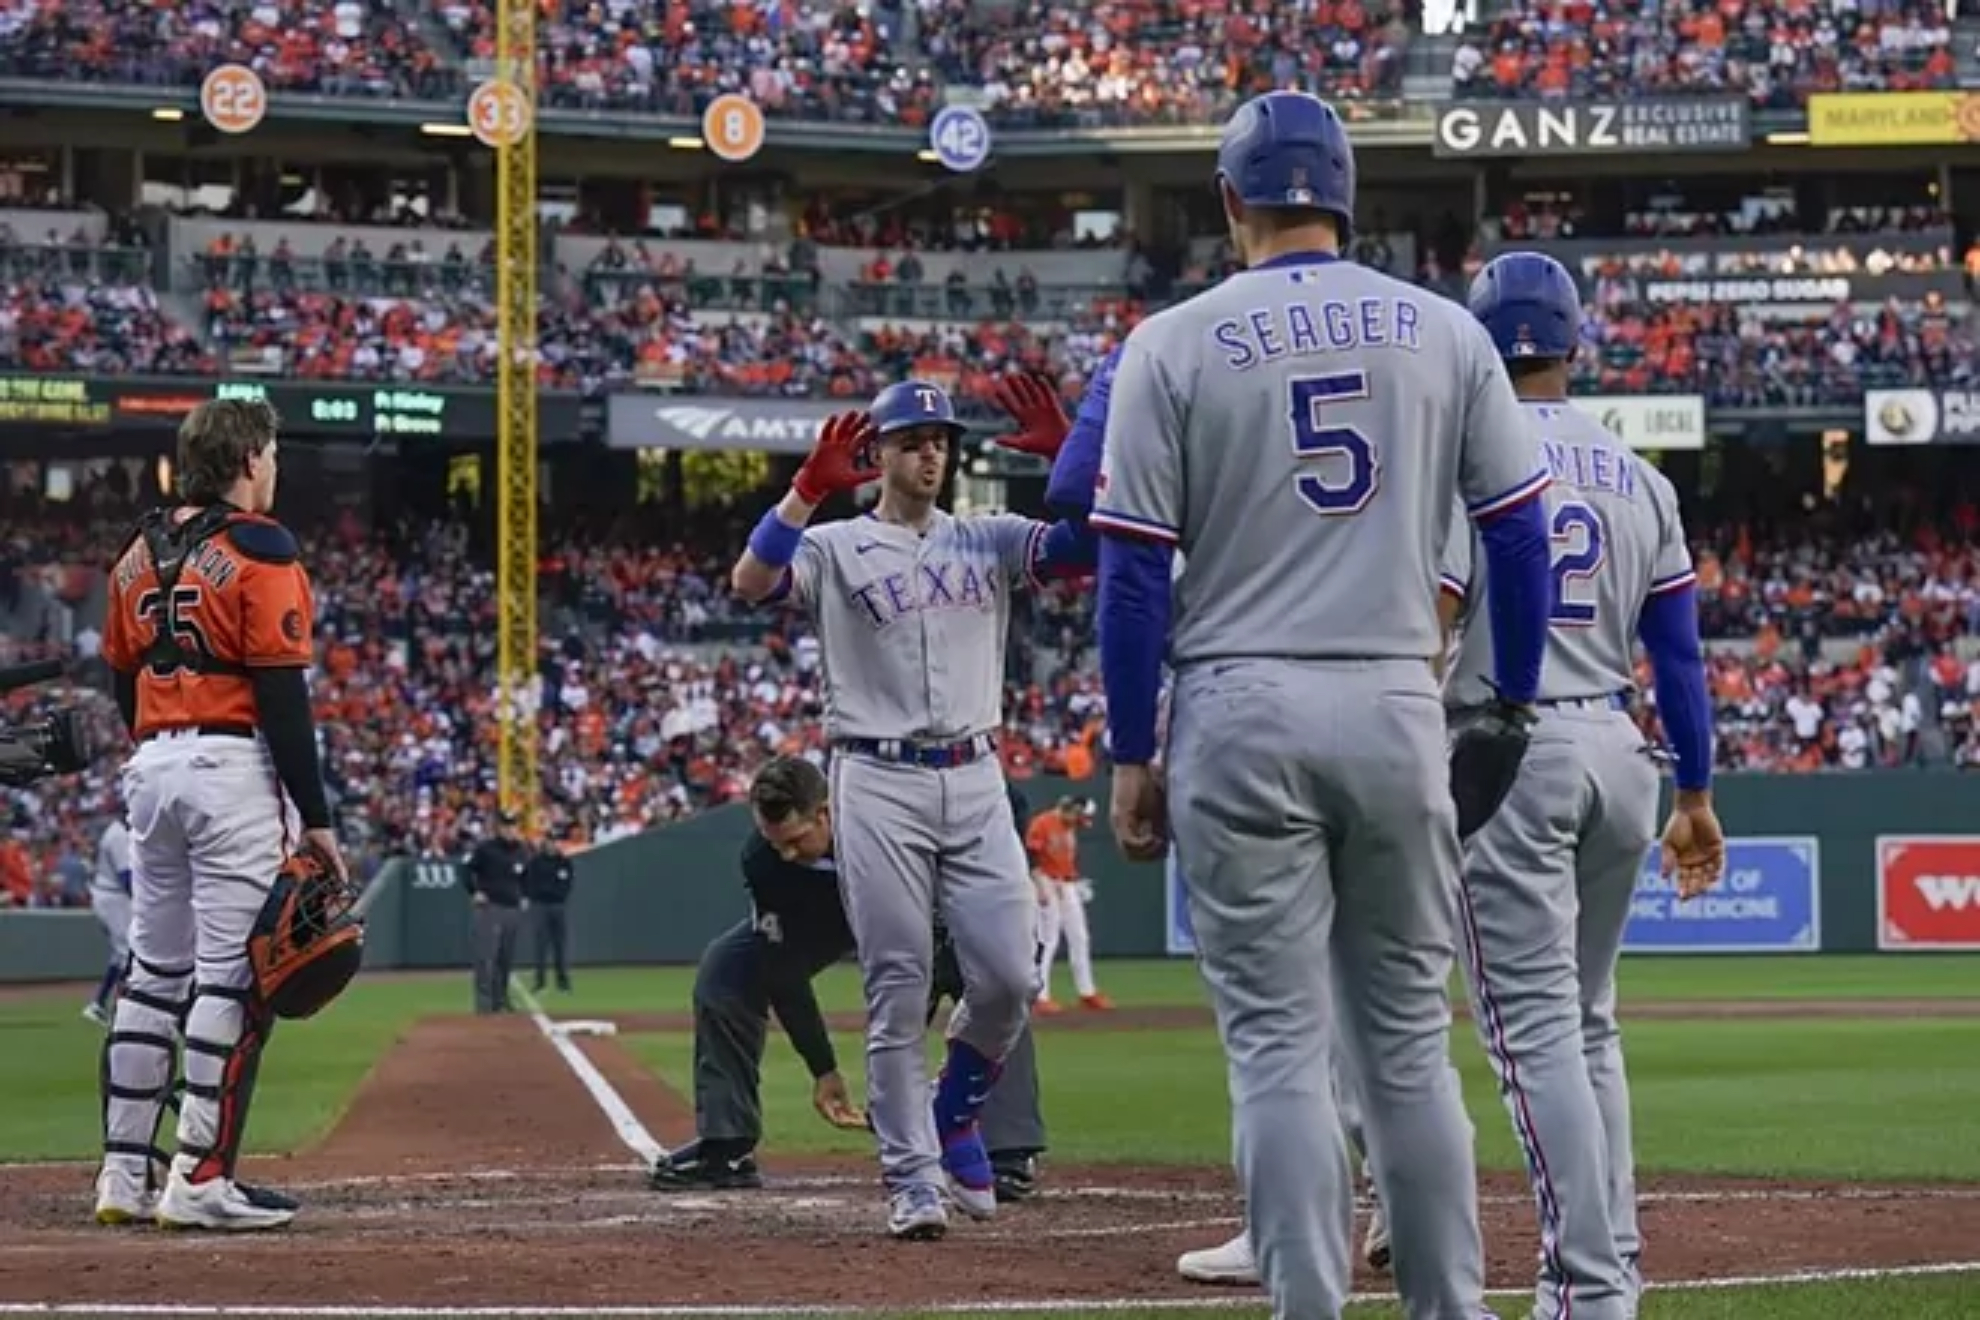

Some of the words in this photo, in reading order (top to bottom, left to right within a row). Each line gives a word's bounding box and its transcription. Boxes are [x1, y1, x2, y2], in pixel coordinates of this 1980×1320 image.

[212, 80, 259, 116] 22
[481, 96, 522, 133] 33
[1622, 102, 1741, 123] EXCLUSIVE
[1825, 107, 1947, 129] MARYLAND
[725, 110, 745, 145] 8
[941, 119, 982, 155] 42
[1441, 107, 1617, 149] GANZ
[1622, 125, 1669, 145] REAL
[1676, 122, 1741, 144] ESTATE
[1647, 281, 1710, 302] PEPSI
[1713, 280, 1770, 300] ZERO
[1773, 278, 1849, 299] SUGAR
[1214, 298, 1421, 370] SEAGER
[914, 389, 937, 412] T
[722, 419, 823, 439] AMT
[1643, 409, 1694, 432] LOCAL
[1287, 369, 1381, 516] 5
[1547, 501, 1605, 627] 2
[412, 863, 456, 888] 333
[1730, 870, 1761, 891] OF
[1671, 897, 1778, 919] MEDICINE
